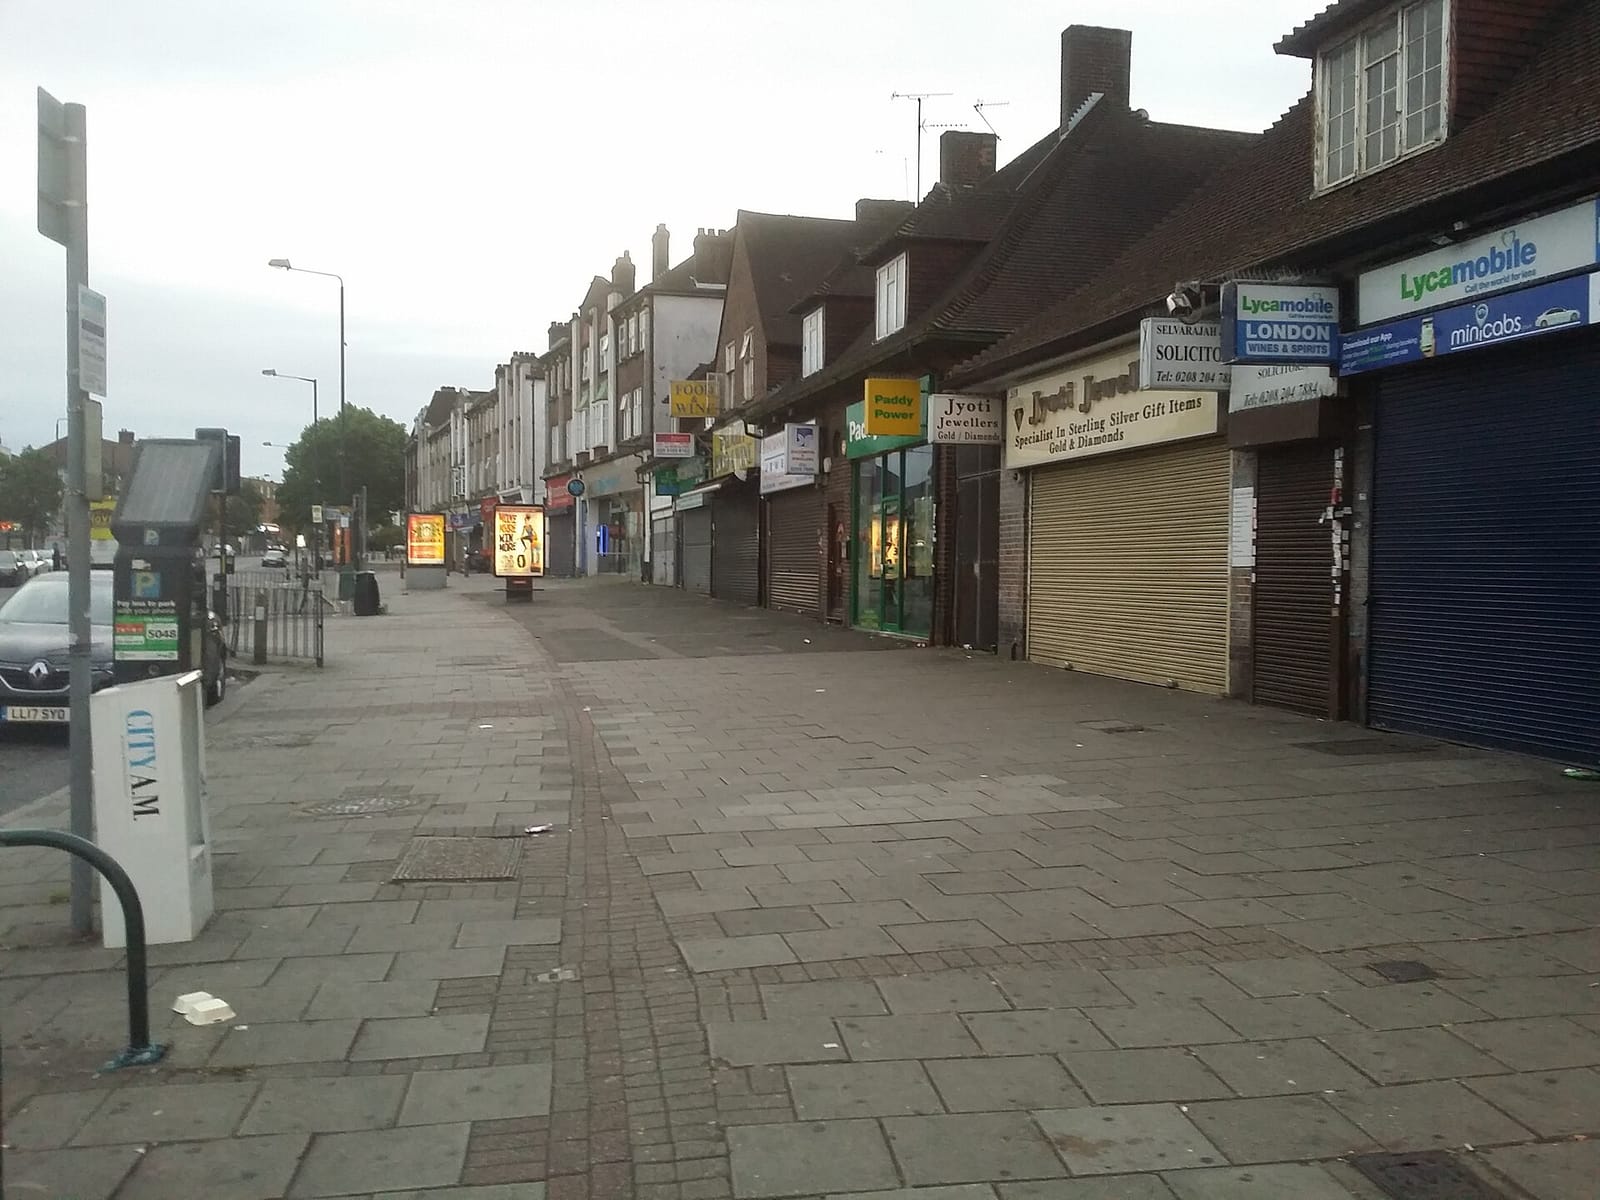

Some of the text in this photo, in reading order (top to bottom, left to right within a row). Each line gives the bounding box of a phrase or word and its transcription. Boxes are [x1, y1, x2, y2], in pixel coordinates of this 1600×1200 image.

[1401, 238, 1537, 302] Lycamobile
[1242, 295, 1334, 314] Lycamobile
[1156, 324, 1217, 337] SELVARAJAH
[1246, 323, 1330, 340] LONDON
[1450, 313, 1522, 346] minicabs
[1380, 333, 1393, 342] App
[1156, 344, 1222, 362] SOLICITO
[1248, 343, 1328, 354] WINES & SPIRITS
[1156, 371, 1173, 382] Tel:
[1175, 371, 1198, 383] 0208
[1199, 372, 1216, 383] 204
[874, 394, 913, 406] Paddy
[1258, 389, 1279, 403] 0208
[874, 409, 914, 419] Power
[944, 398, 991, 416] Jyoti
[937, 416, 999, 429] Jewellers
[1015, 397, 1202, 450] Specialist In Sterling Silver Gift Items
[938, 431, 956, 440] Gold
[964, 432, 1000, 441] Diamonds
[1049, 428, 1124, 454] Gold & Diamonds
[11, 709, 38, 719] LL17
[126, 709, 160, 822] CITY A.M.
